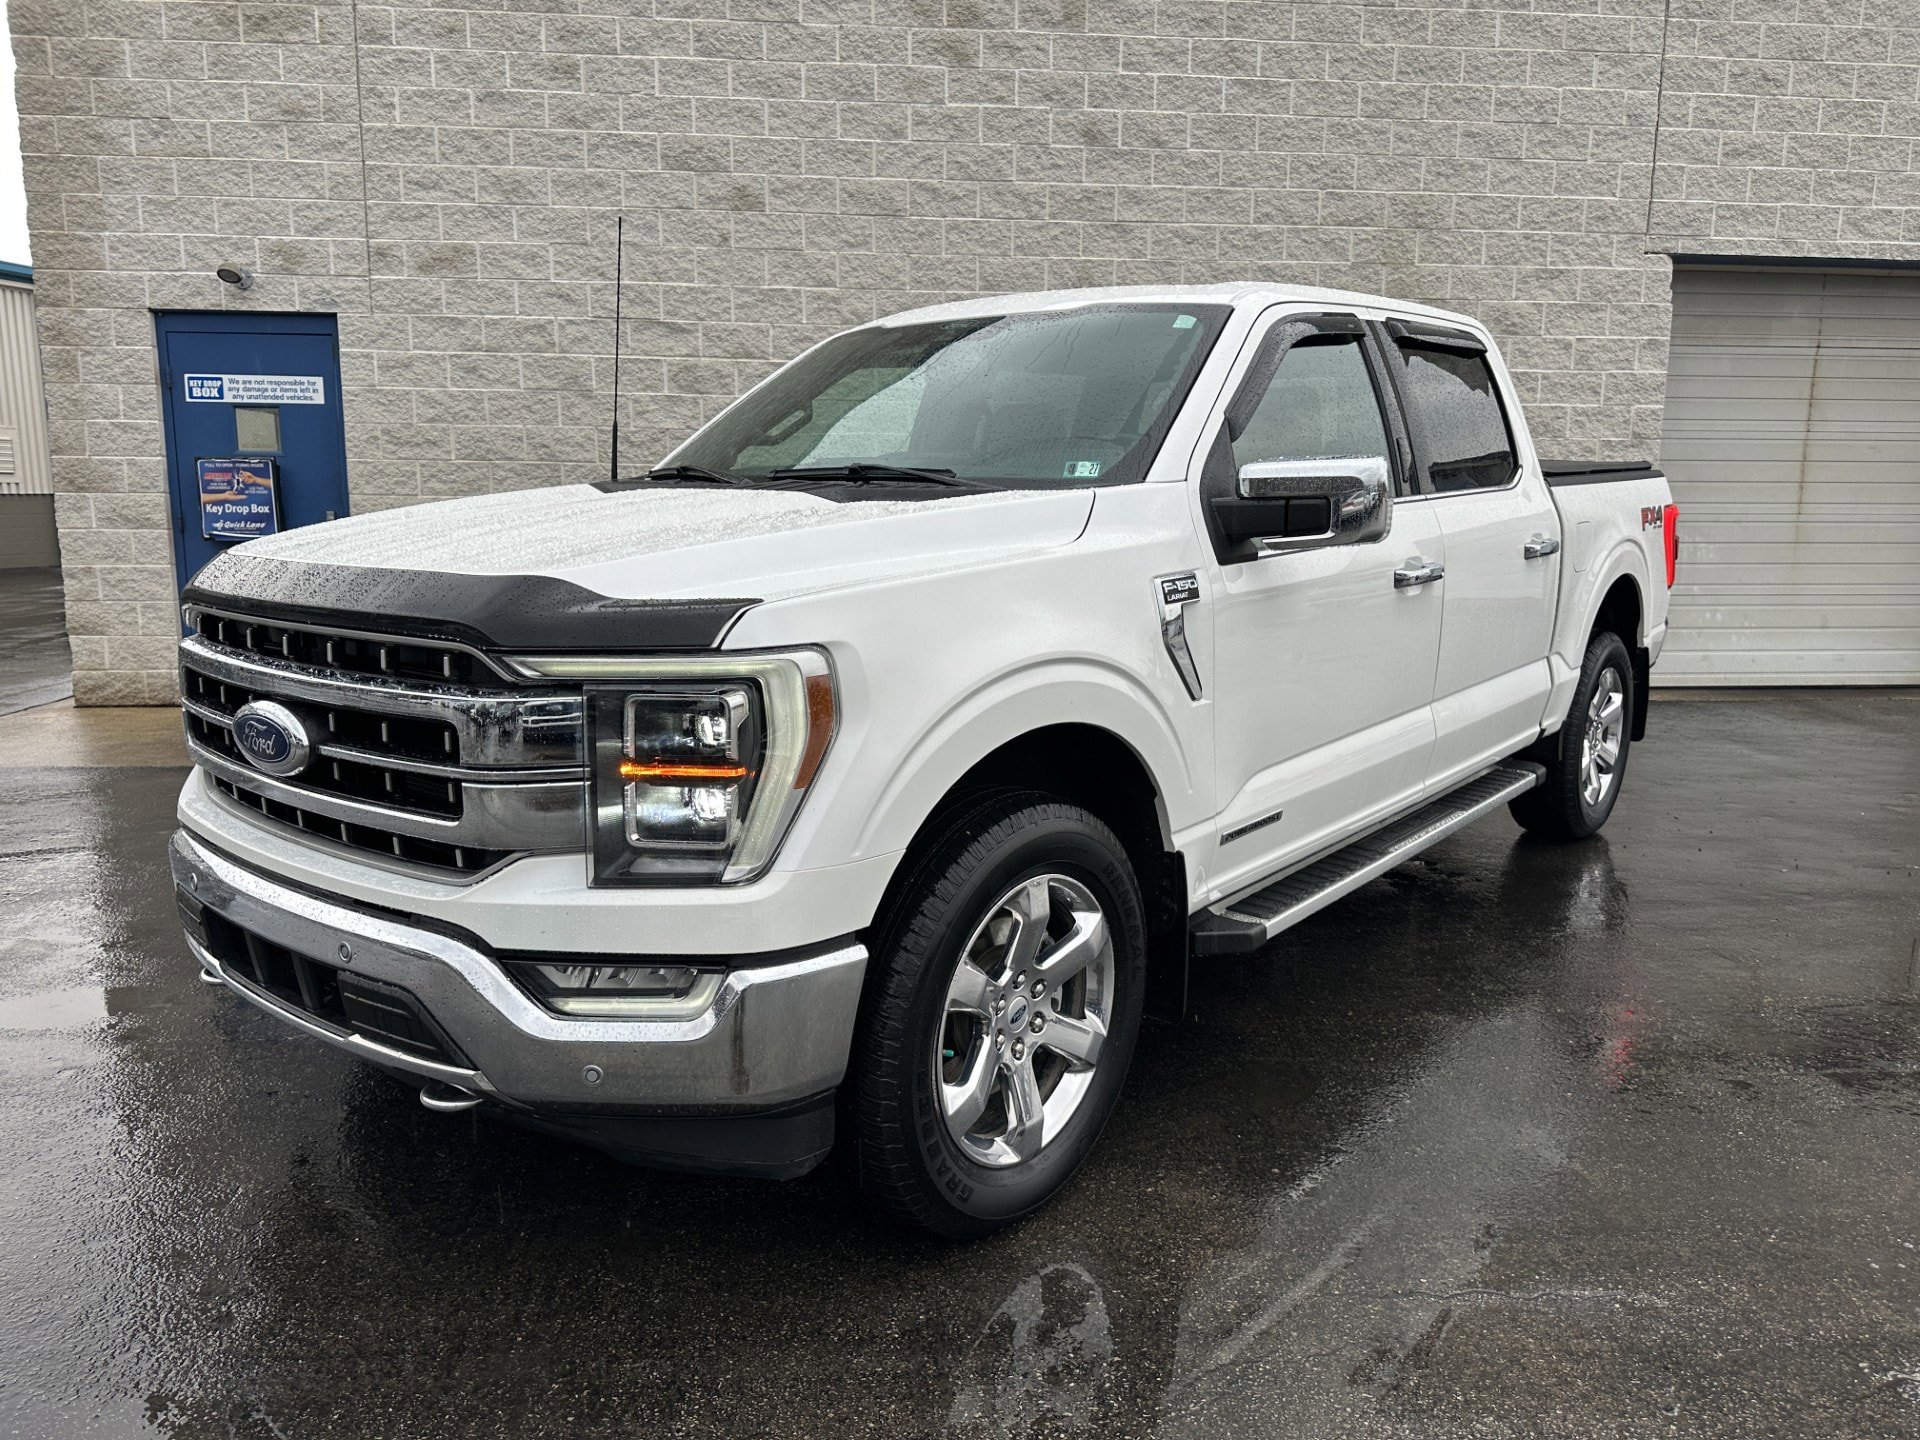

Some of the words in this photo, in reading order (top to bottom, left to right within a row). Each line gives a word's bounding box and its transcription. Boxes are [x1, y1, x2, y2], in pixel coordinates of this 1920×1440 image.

[203, 380, 221, 388] DROP
[266, 379, 305, 387] responsible
[192, 387, 220, 398] BOX
[242, 386, 268, 394] damage
[1089, 463, 1099, 474] 27
[205, 503, 223, 515] Key
[224, 503, 249, 515] Drop
[251, 503, 270, 513] Box
[1641, 504, 1662, 531] FX4
[224, 520, 246, 528] Quick
[1162, 578, 1198, 593] F-150
[1167, 591, 1189, 601] LARIAT
[243, 720, 277, 755] Ford
[1221, 811, 1281, 843] POWERBOOST
